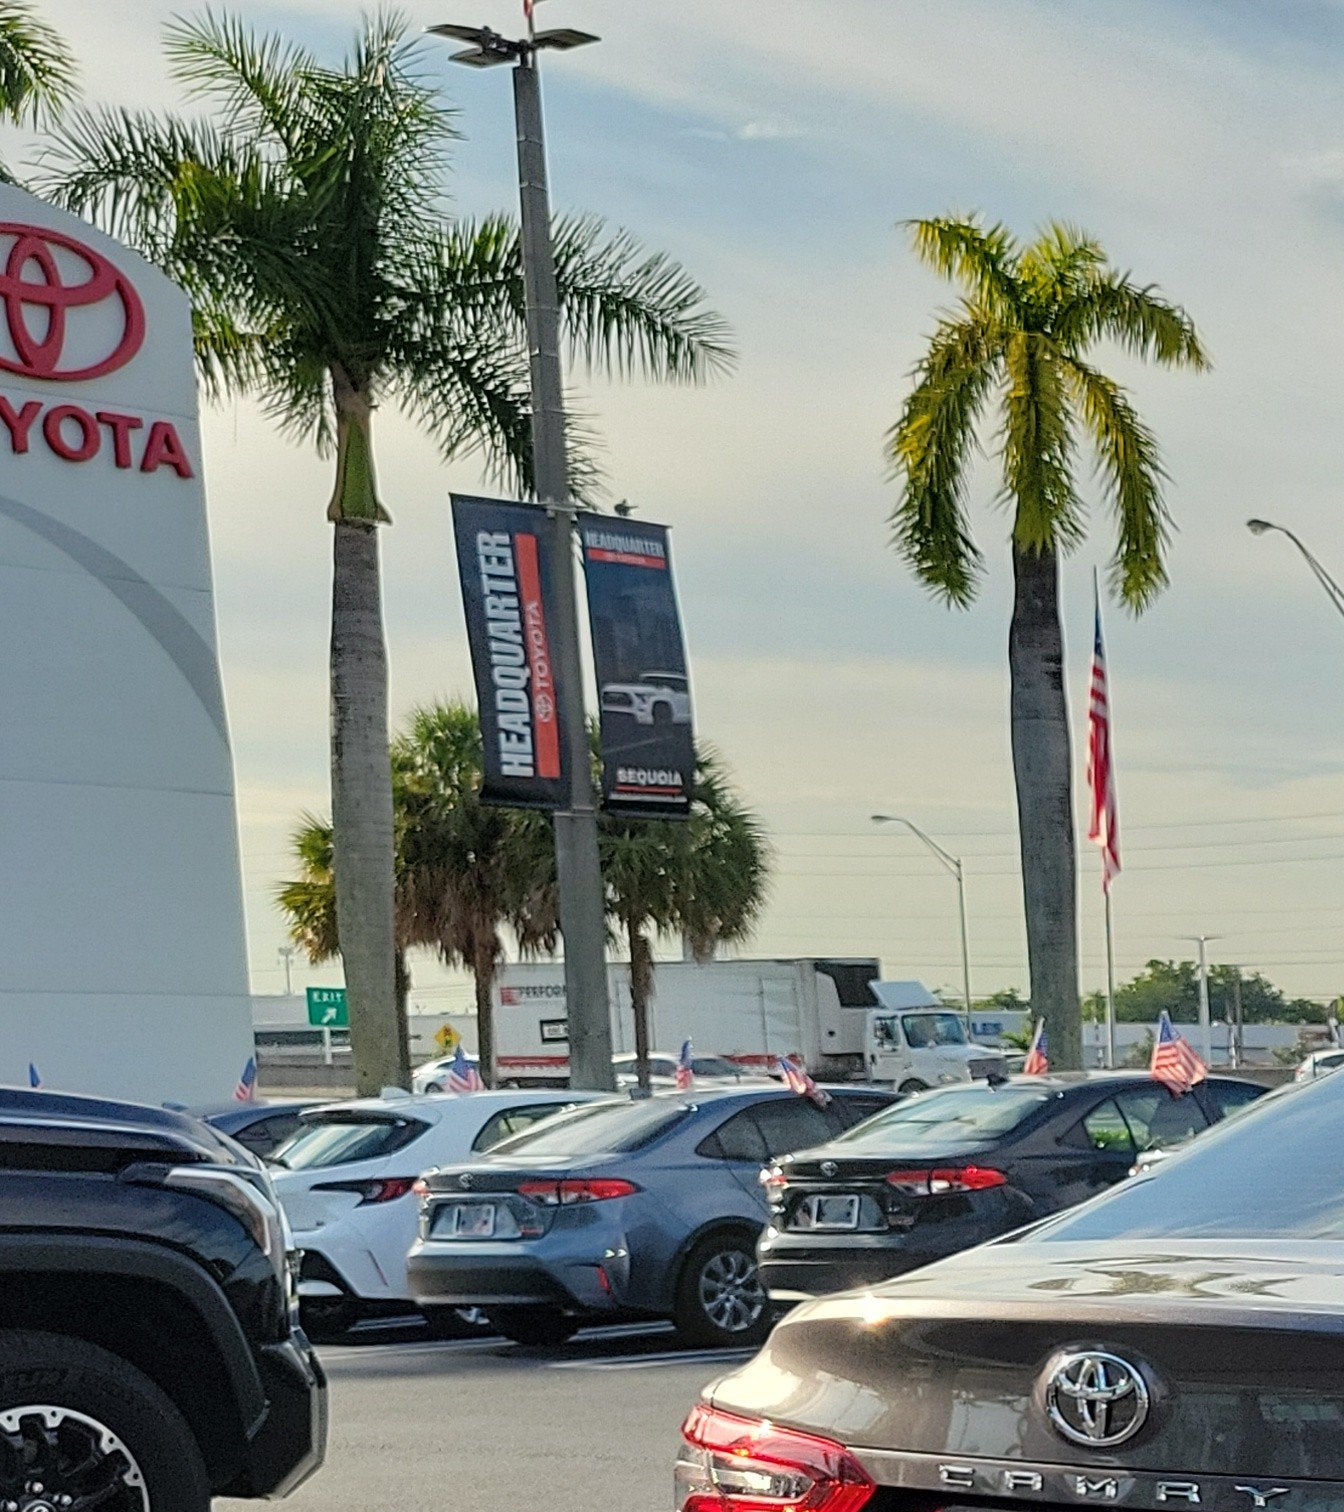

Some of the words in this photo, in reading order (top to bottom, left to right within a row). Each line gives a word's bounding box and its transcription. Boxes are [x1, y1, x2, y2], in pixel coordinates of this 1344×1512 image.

[476, 530, 534, 777] HEADQUARTER
[525, 602, 551, 689] TOYOTA
[616, 766, 683, 787] SEQUOIA
[312, 991, 343, 1003] EXIT
[939, 1464, 1291, 1507] CAMRY
